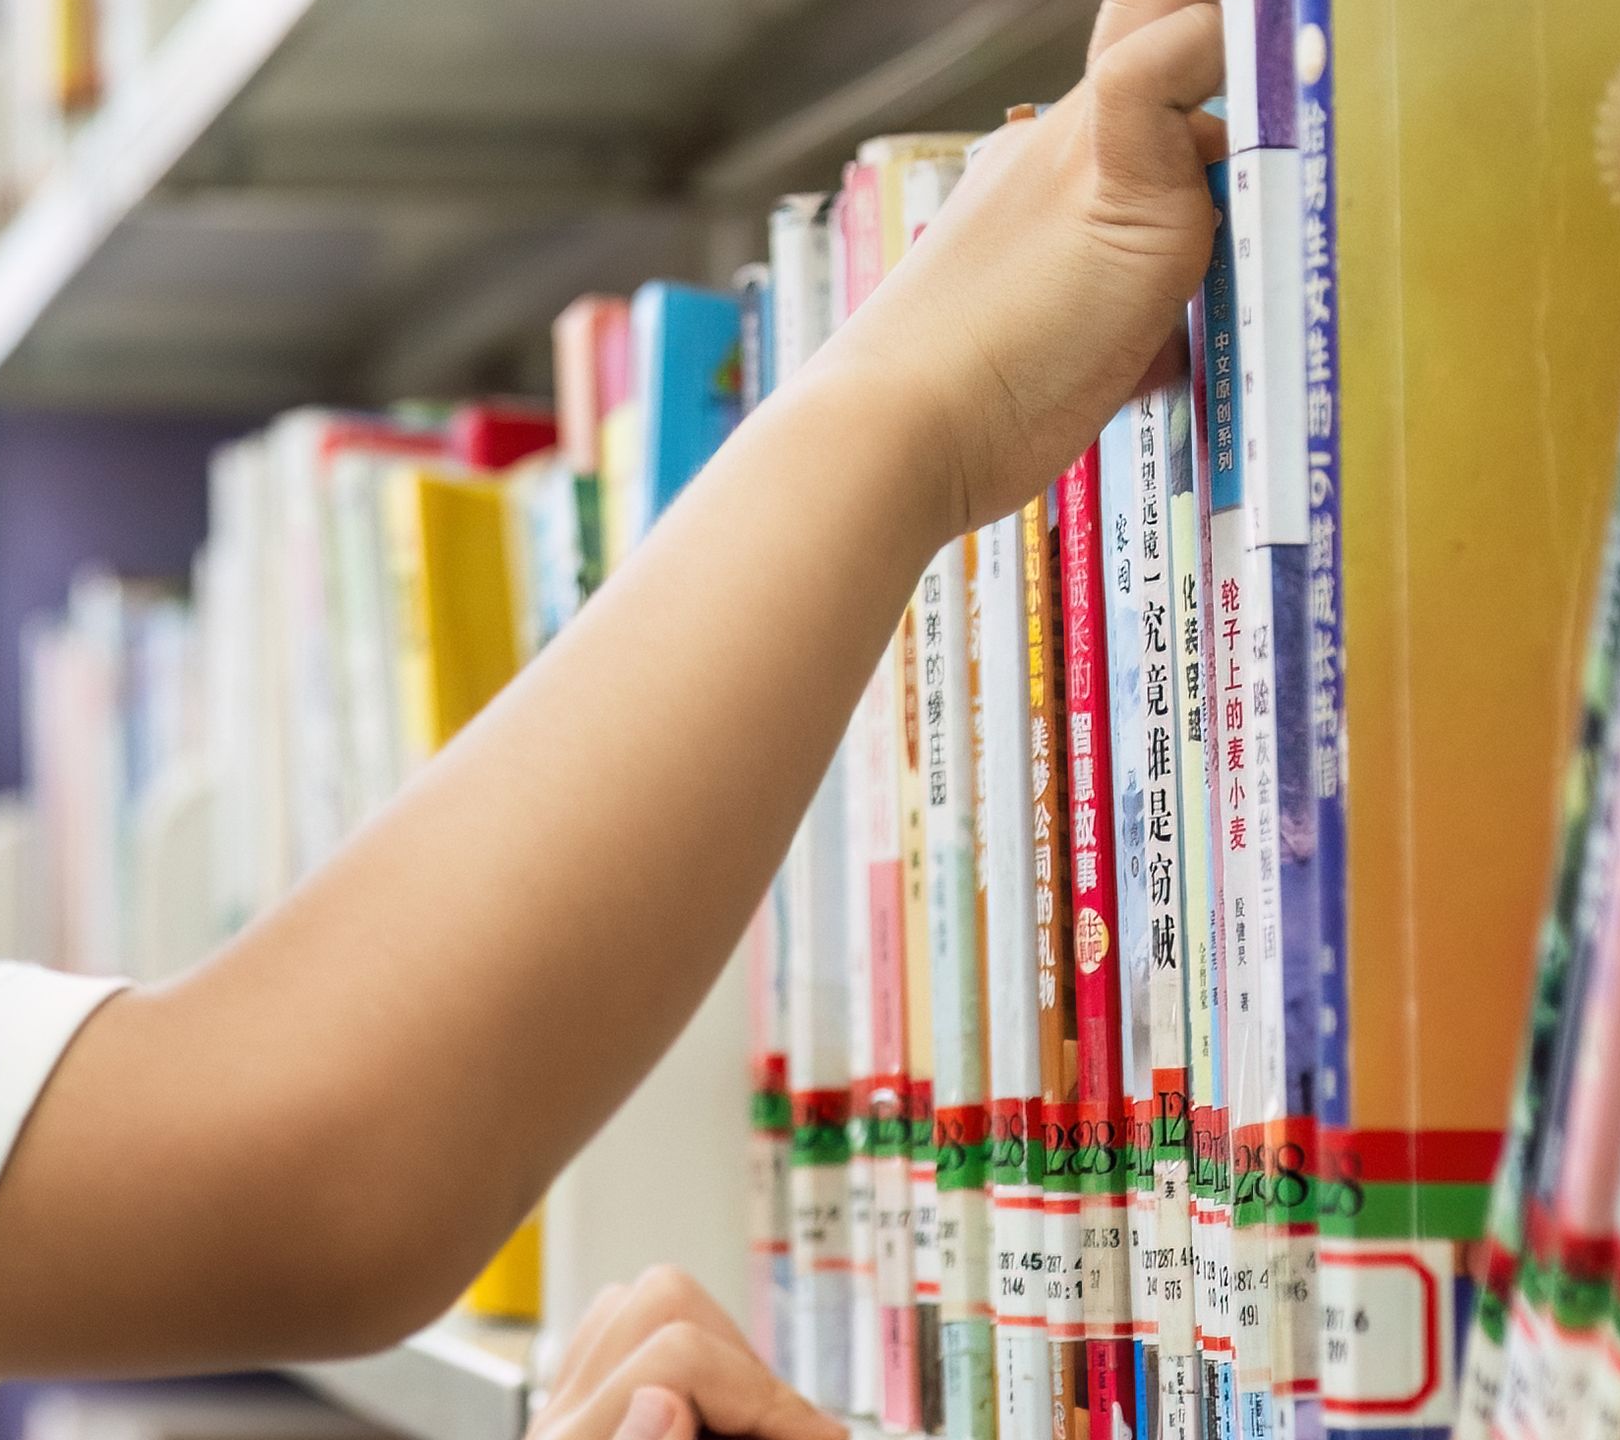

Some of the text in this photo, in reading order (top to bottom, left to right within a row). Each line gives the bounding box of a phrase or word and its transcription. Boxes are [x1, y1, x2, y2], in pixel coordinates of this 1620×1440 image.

[1220, 578, 1248, 852] 轮子上的麦小麦
[1032, 717, 1056, 1010] 美梦公司的礼物
[1164, 1278, 1183, 1302] 575
